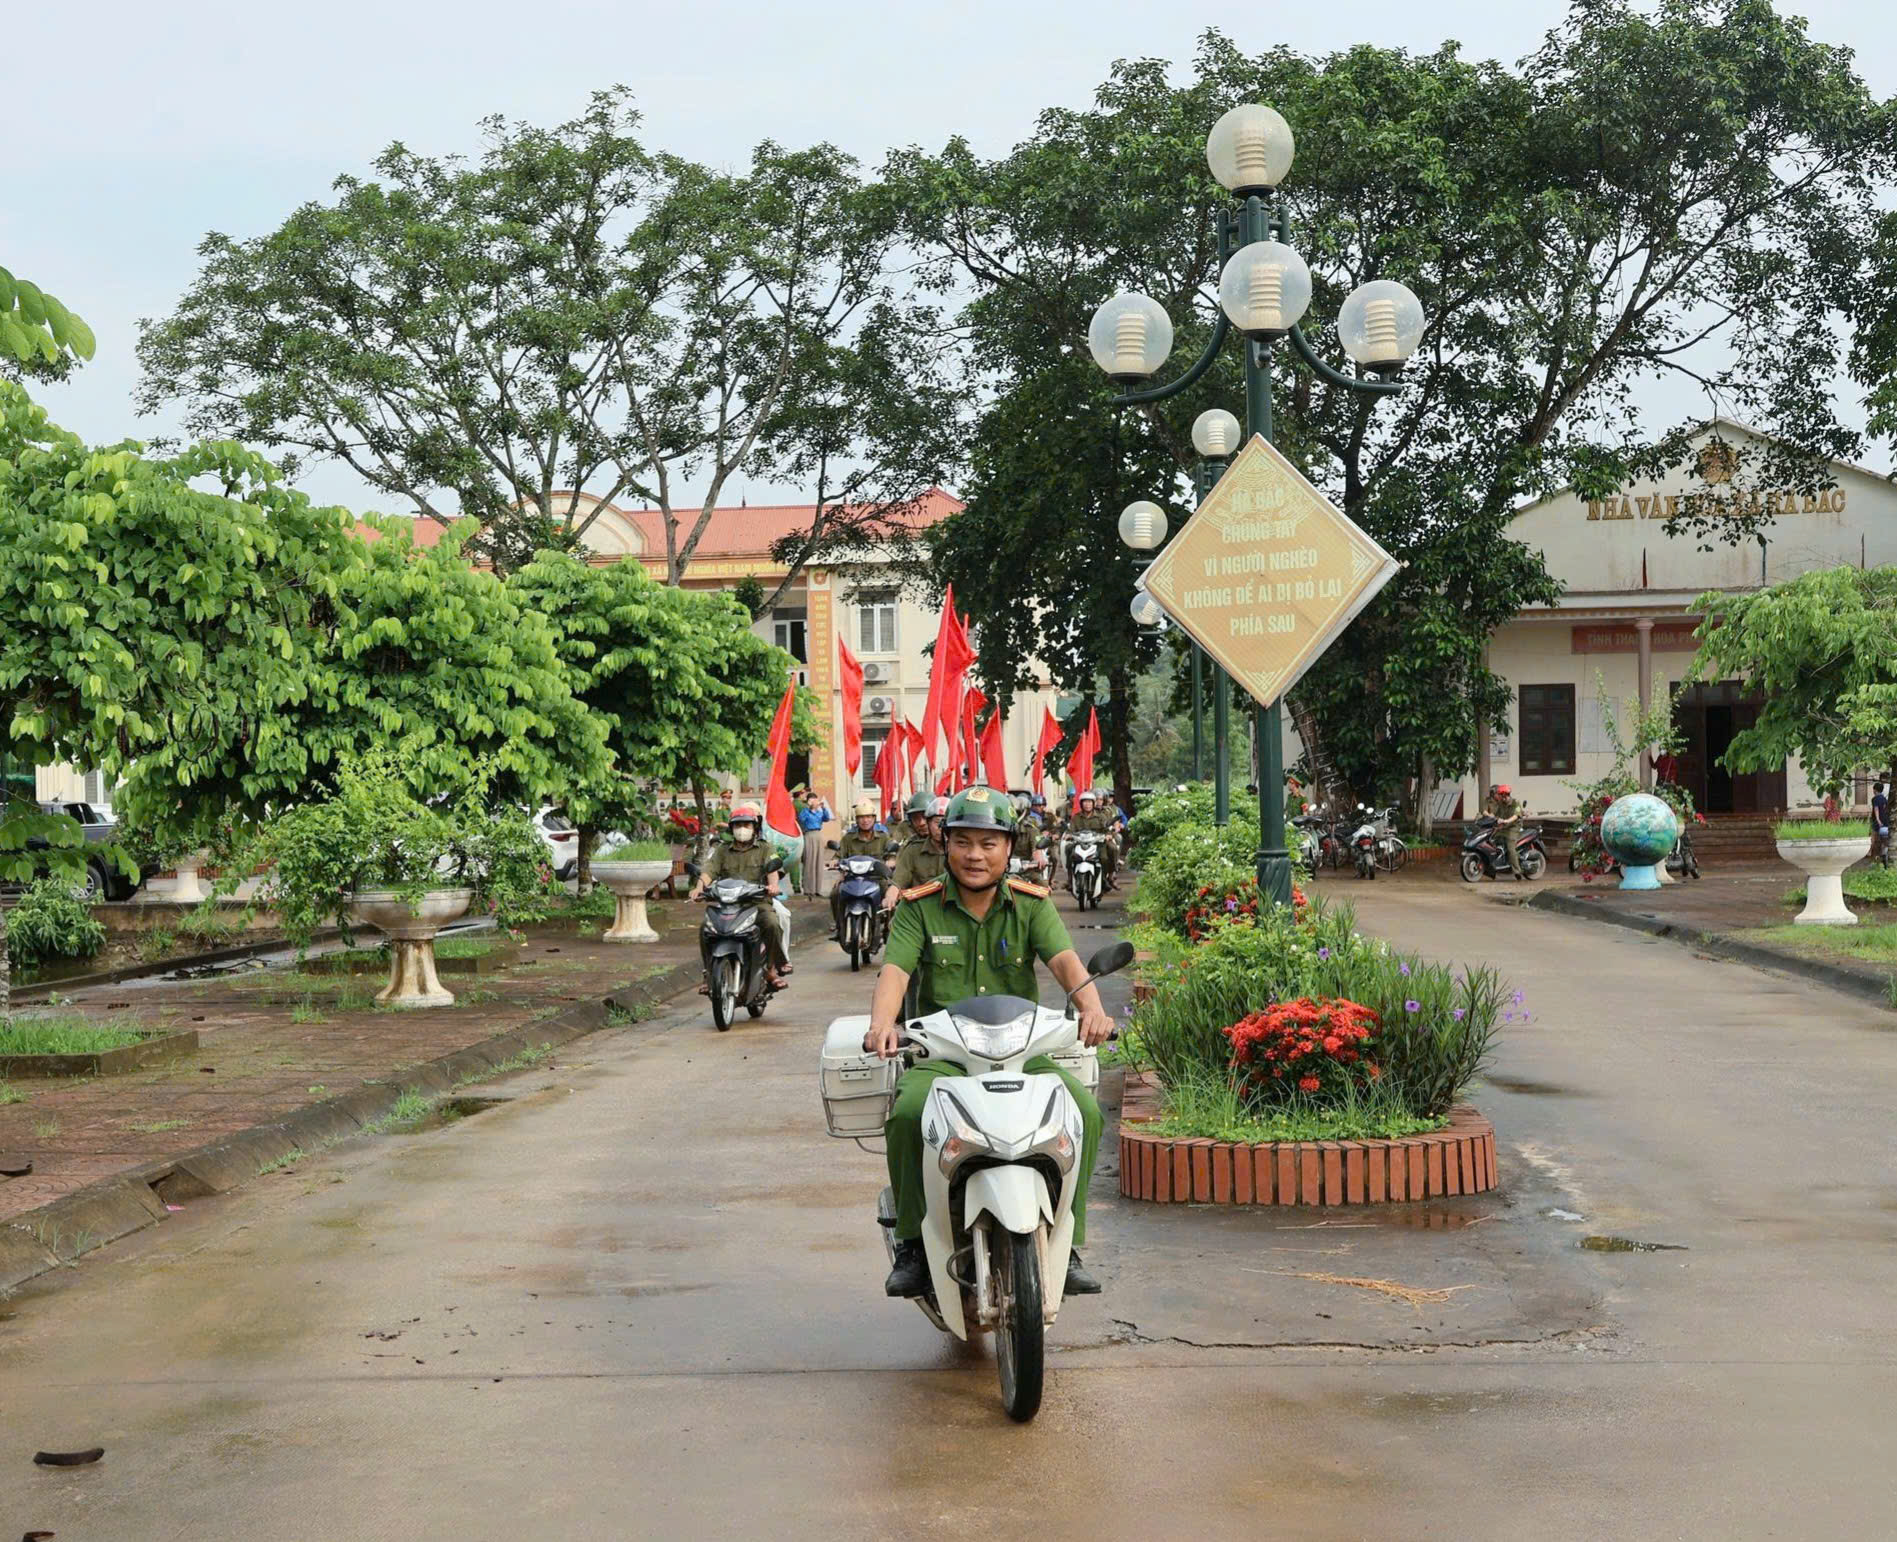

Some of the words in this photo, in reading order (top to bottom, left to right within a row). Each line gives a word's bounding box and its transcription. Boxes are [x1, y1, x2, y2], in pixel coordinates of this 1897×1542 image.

[1587, 492, 1634, 520] NHÀ
[1223, 522, 1270, 543] CHUNG
[1272, 519, 1296, 539] TAY
[1204, 553, 1217, 576] VÌ
[1222, 551, 1265, 575] NGƯỜI
[1269, 546, 1318, 570] NGHÈO
[1183, 586, 1232, 609] KHÔNG
[1236, 578, 1254, 605] ĐỂ
[1258, 584, 1272, 603] AI
[1276, 583, 1291, 606] BỊ
[1295, 576, 1314, 601] BỎ
[1319, 578, 1342, 601] LẠI
[1231, 613, 1264, 636] PHÍA
[1268, 614, 1295, 634] SAU
